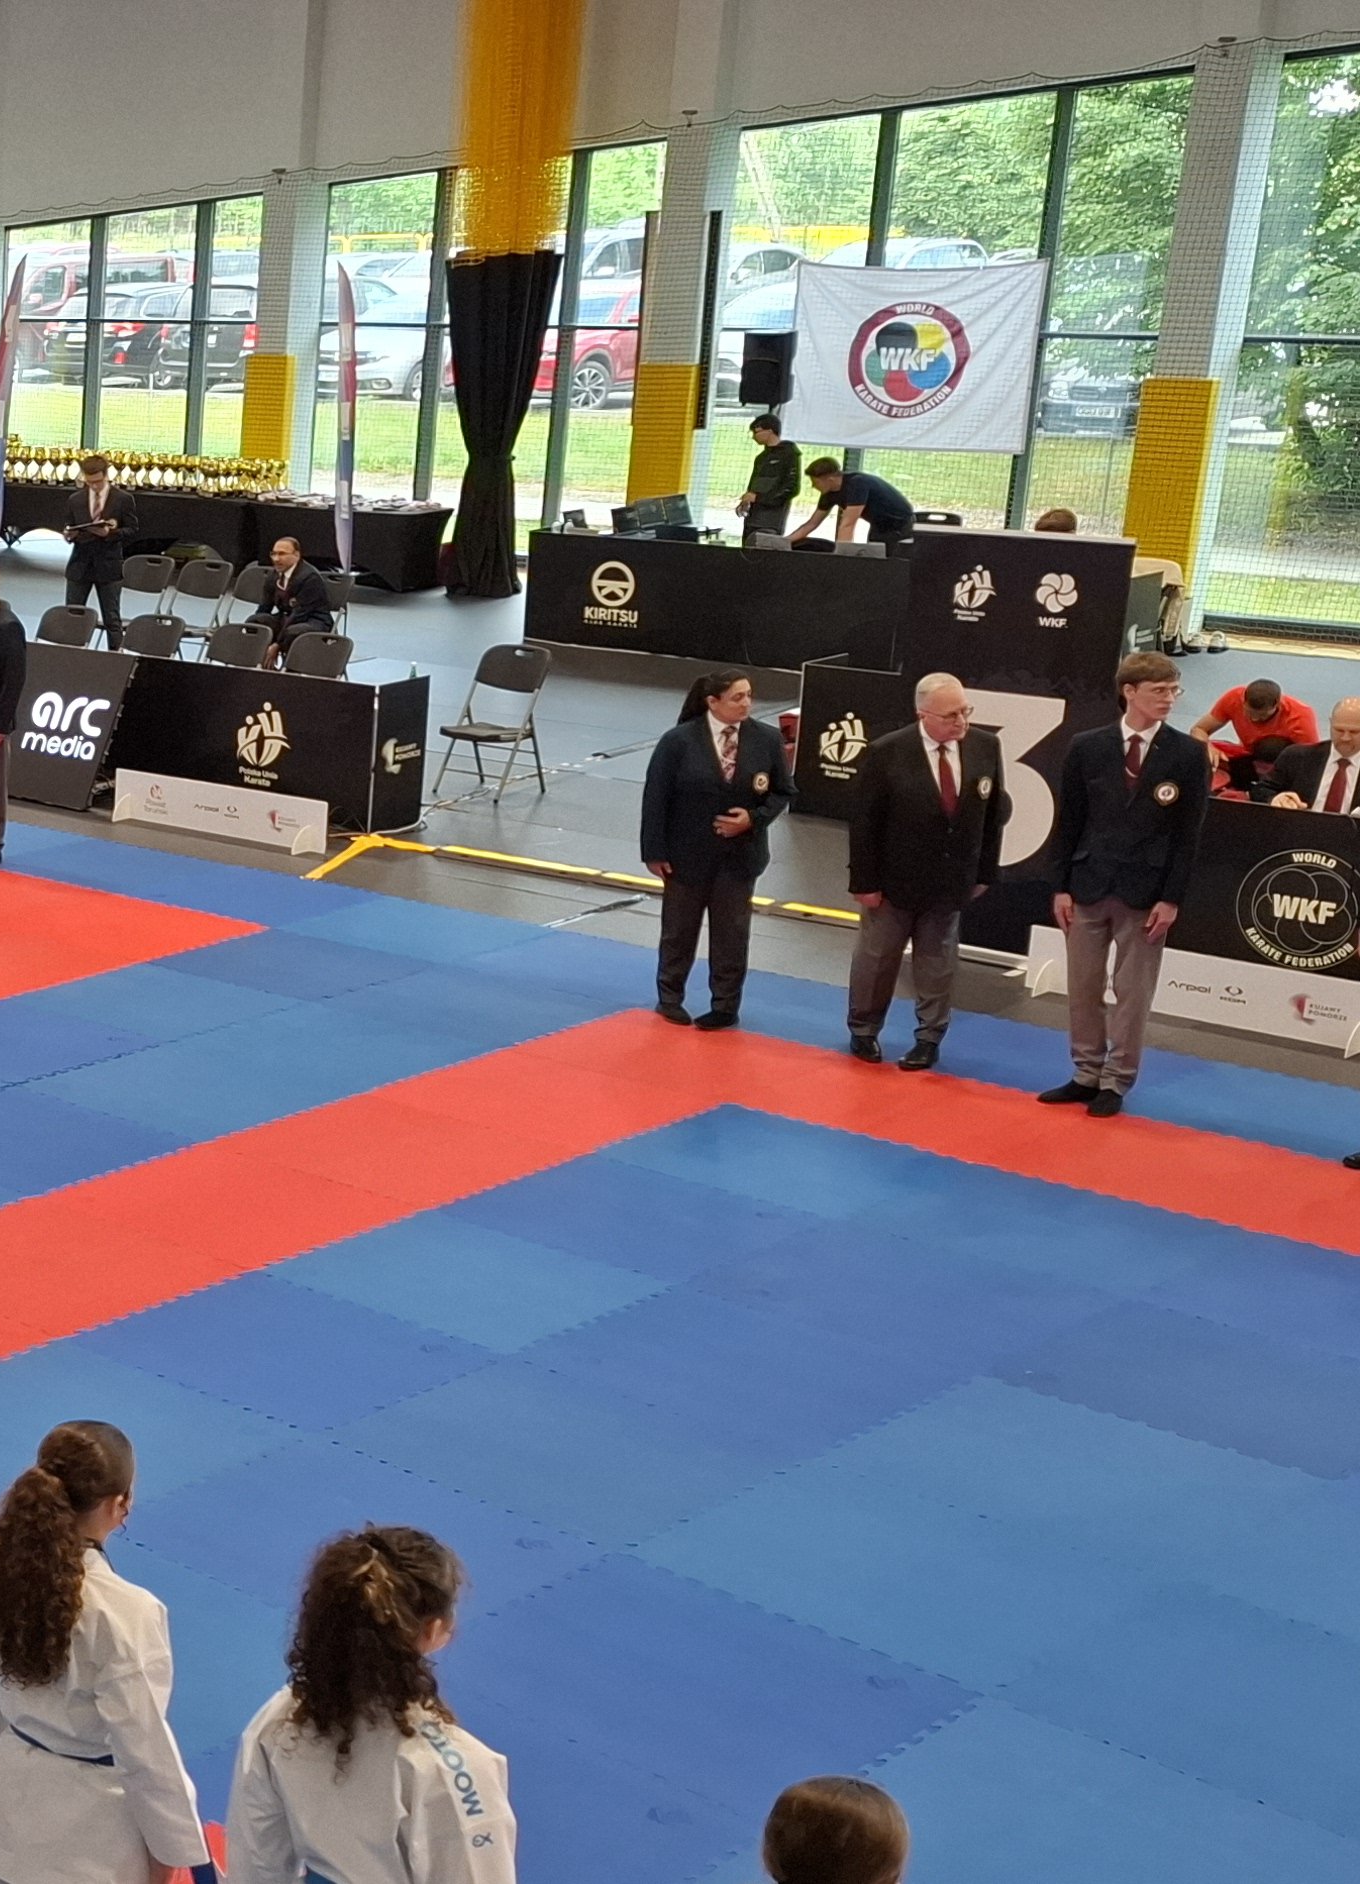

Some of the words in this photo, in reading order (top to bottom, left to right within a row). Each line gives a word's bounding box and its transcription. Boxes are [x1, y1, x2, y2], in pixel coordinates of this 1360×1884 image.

[896, 303, 935, 316] WORLD
[880, 347, 936, 372] WKF
[854, 383, 890, 413] KARATE
[891, 385, 952, 417] FEDERATION
[583, 606, 639, 623] KIRITSU
[1038, 617, 1067, 628] WKF
[31, 691, 111, 738] arc
[21, 731, 96, 761] media
[960, 687, 1066, 868] 3
[1292, 852, 1337, 869] WORLD
[1273, 893, 1337, 925] WKF
[1245, 927, 1283, 961] KARATE
[1284, 942, 1355, 968] FEDERATION
[1168, 979, 1211, 994] Arpol
